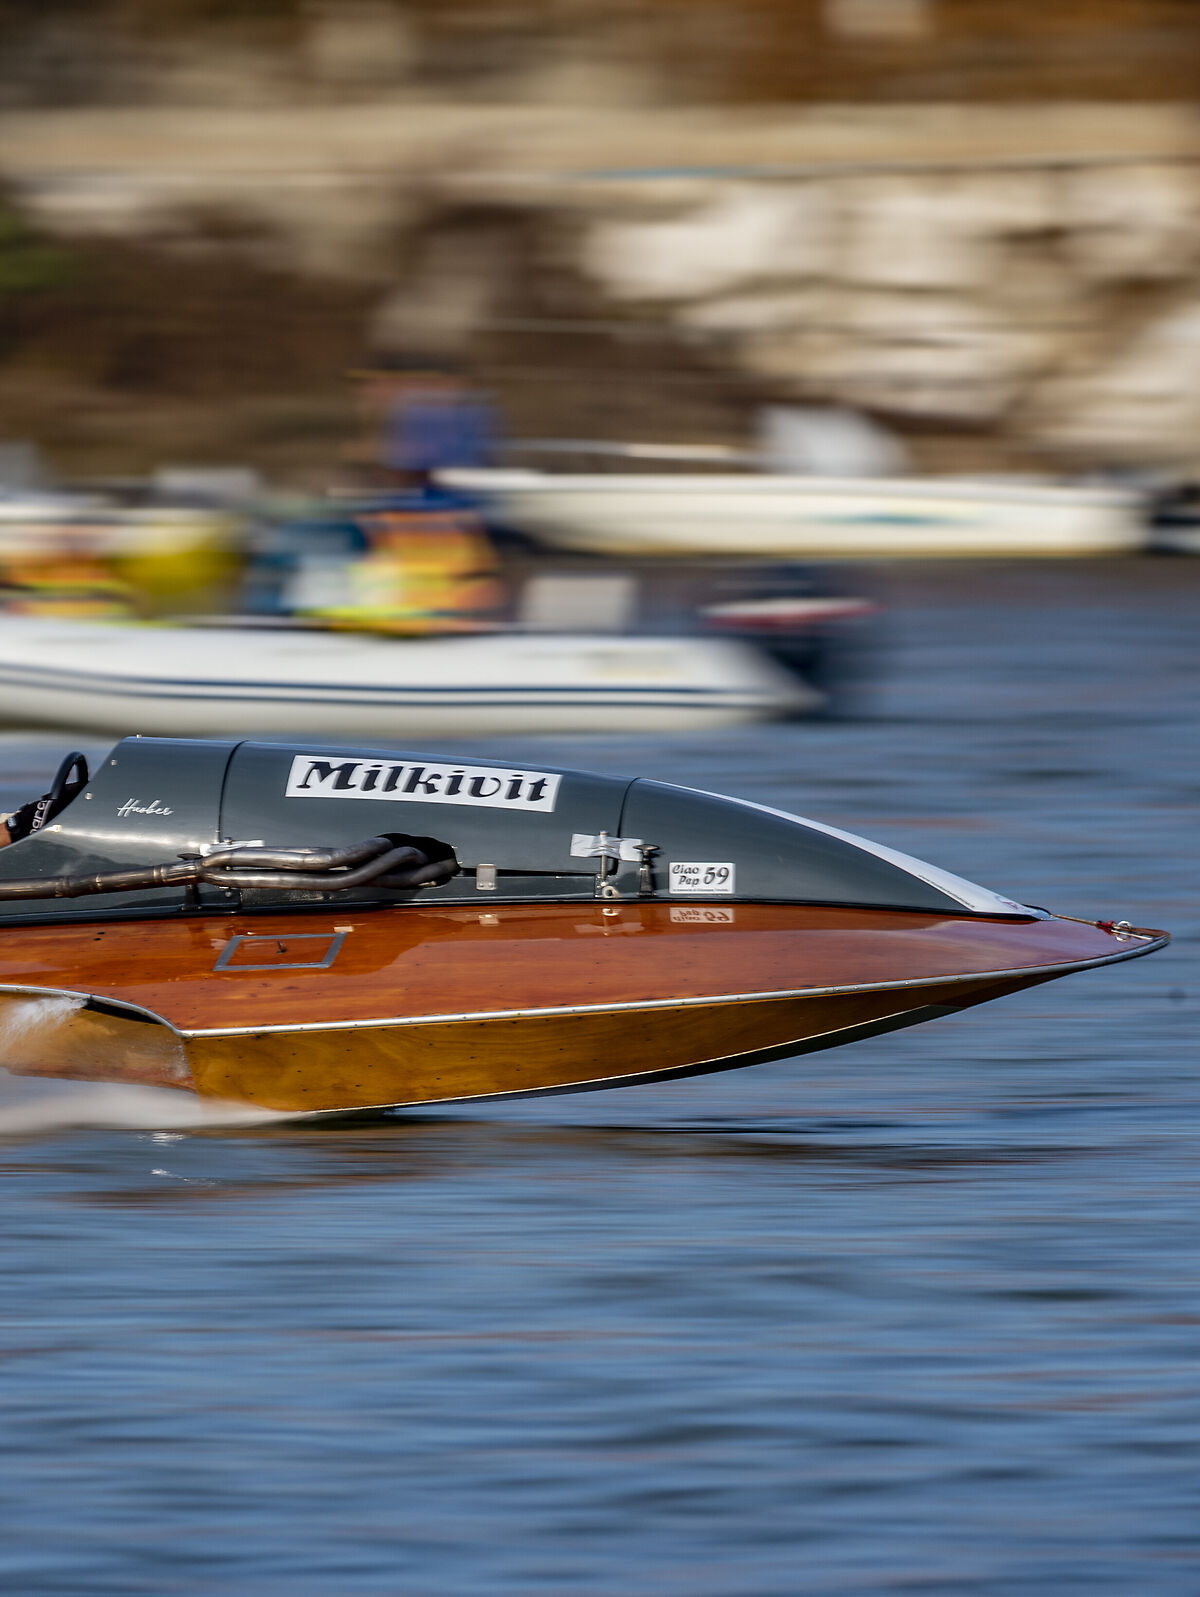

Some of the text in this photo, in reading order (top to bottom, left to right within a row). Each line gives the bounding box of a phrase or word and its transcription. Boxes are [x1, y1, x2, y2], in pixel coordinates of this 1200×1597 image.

[296, 761, 550, 802] Milkivit
[672, 865, 700, 874] Ciao
[703, 866, 730, 885] 59
